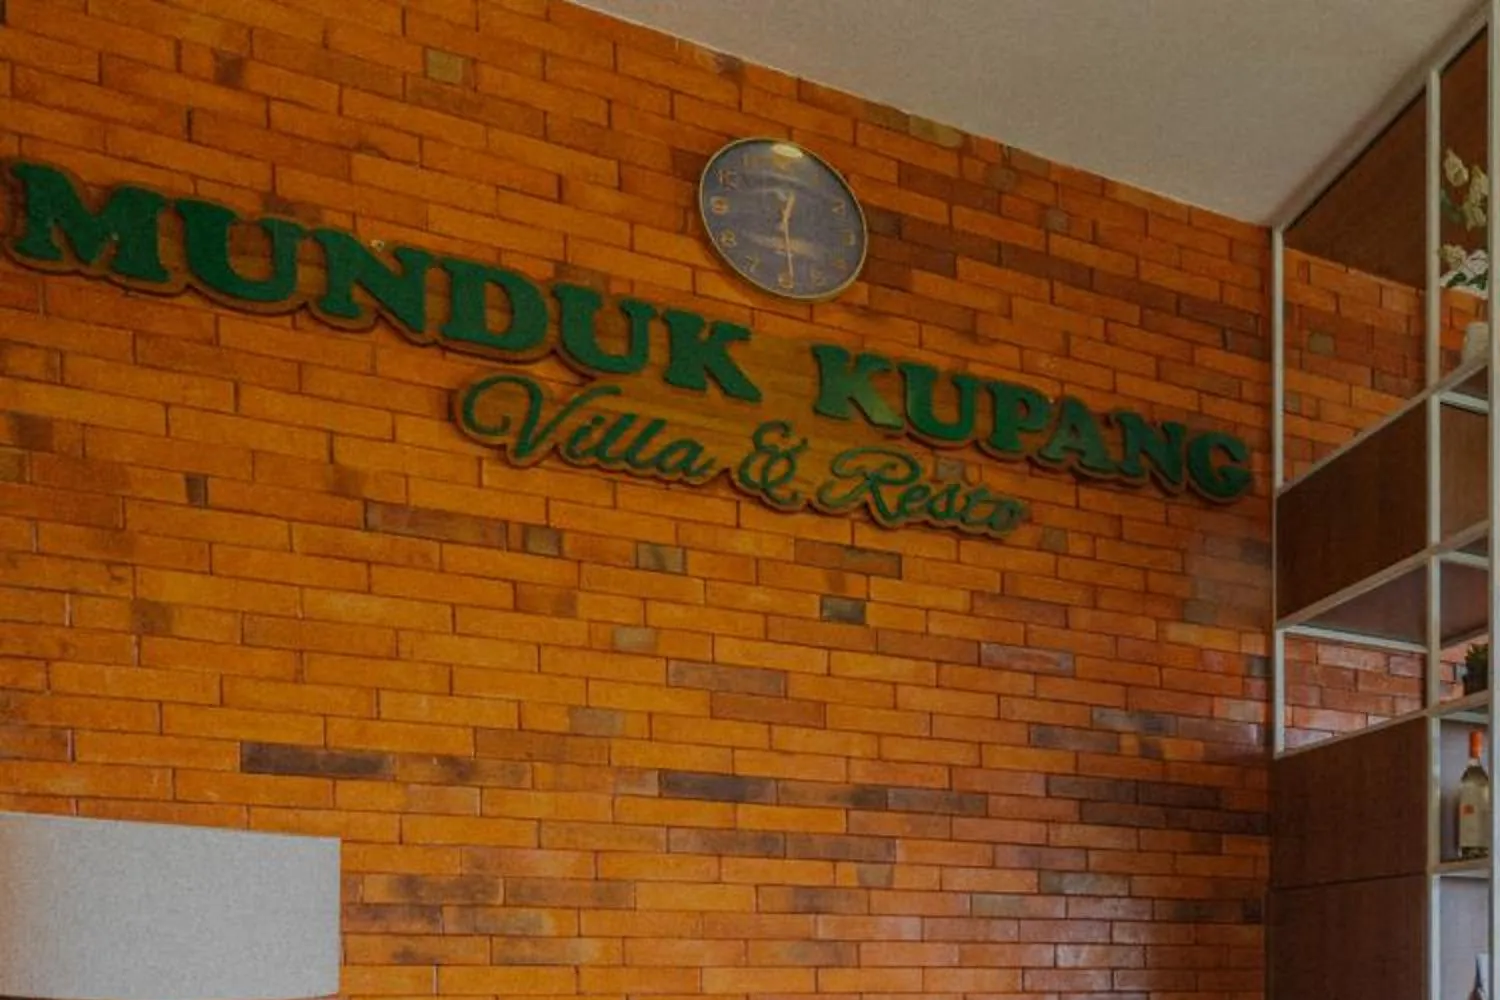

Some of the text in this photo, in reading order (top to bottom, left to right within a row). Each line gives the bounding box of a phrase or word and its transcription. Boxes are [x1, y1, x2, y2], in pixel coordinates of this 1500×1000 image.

[9, 161, 1254, 498] MUNDUK KUPANG
[461, 374, 1028, 536] Villa & Resto
